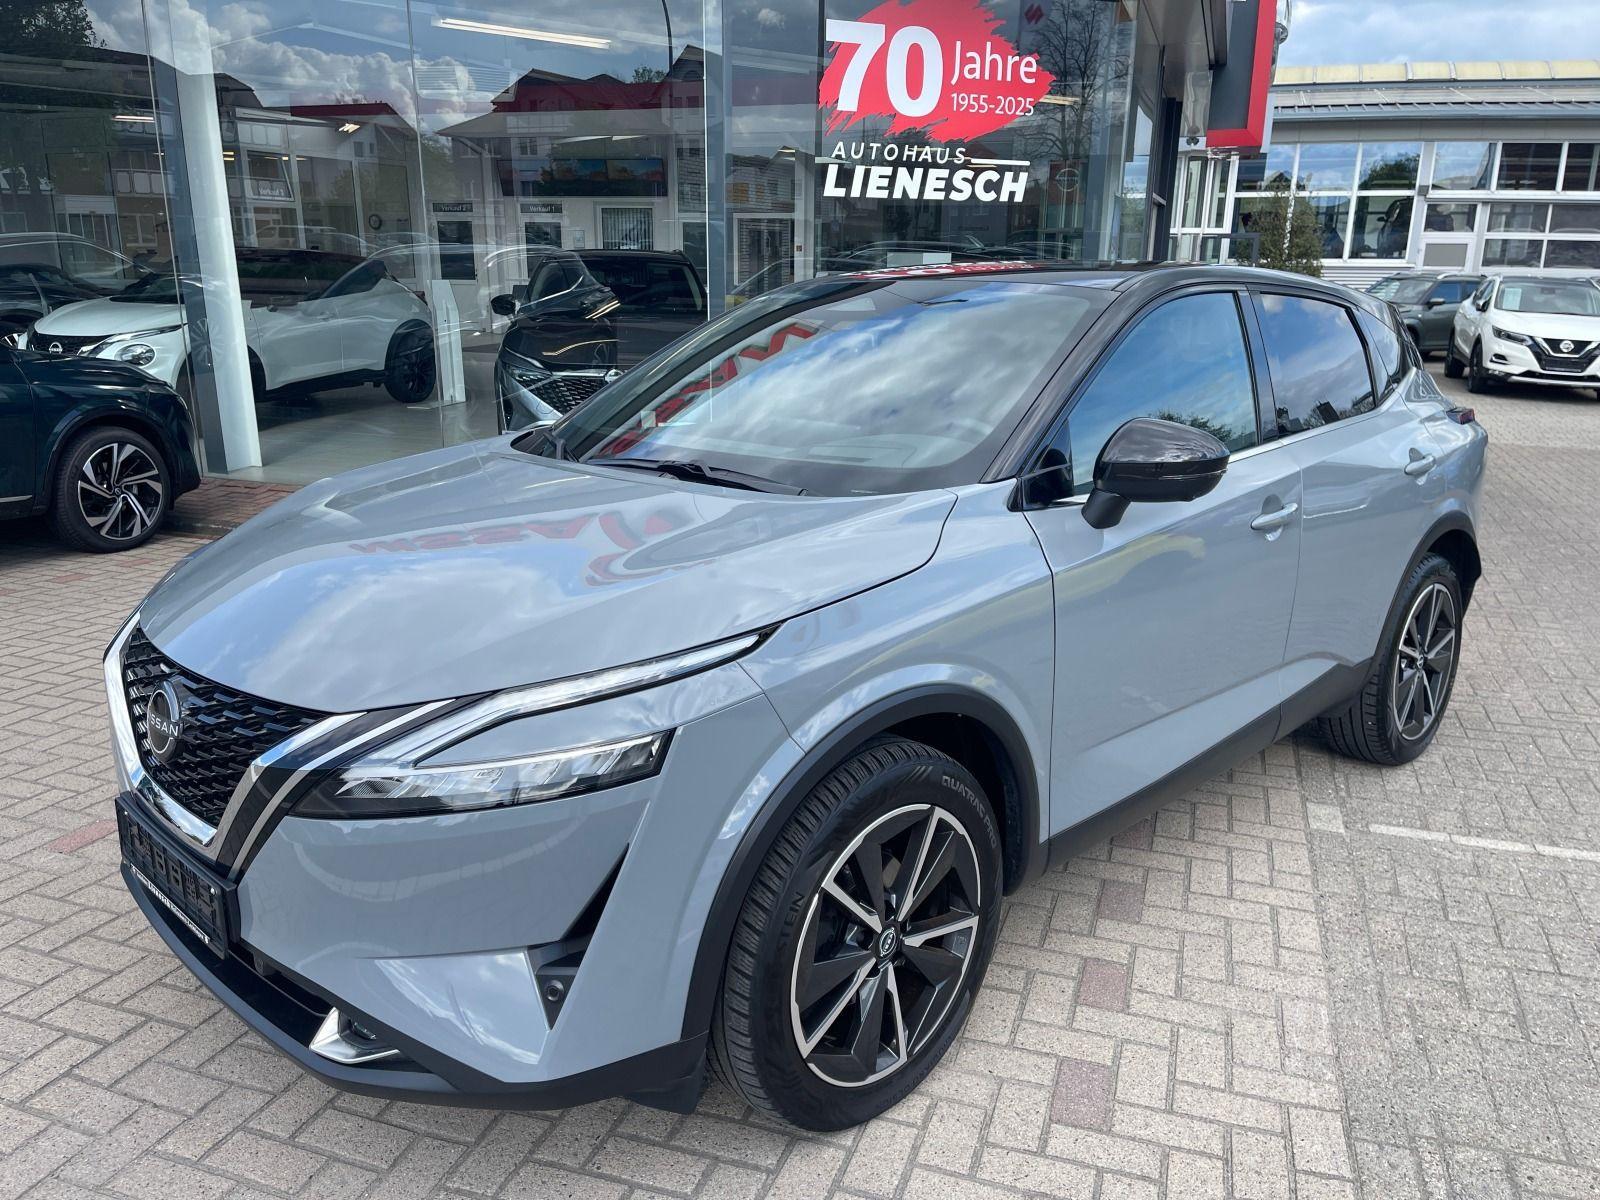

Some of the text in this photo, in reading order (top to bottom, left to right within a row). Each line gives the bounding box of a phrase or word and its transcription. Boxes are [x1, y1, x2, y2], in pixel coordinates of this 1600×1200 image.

[825, 18, 1038, 118] 70 Jahre
[951, 92, 1035, 117] 1955-2025
[831, 141, 967, 165] AUTOHAUS
[823, 163, 1029, 203] LIENESCH
[150, 712, 179, 738] SSAN
[942, 775, 986, 819] QUATRAC
